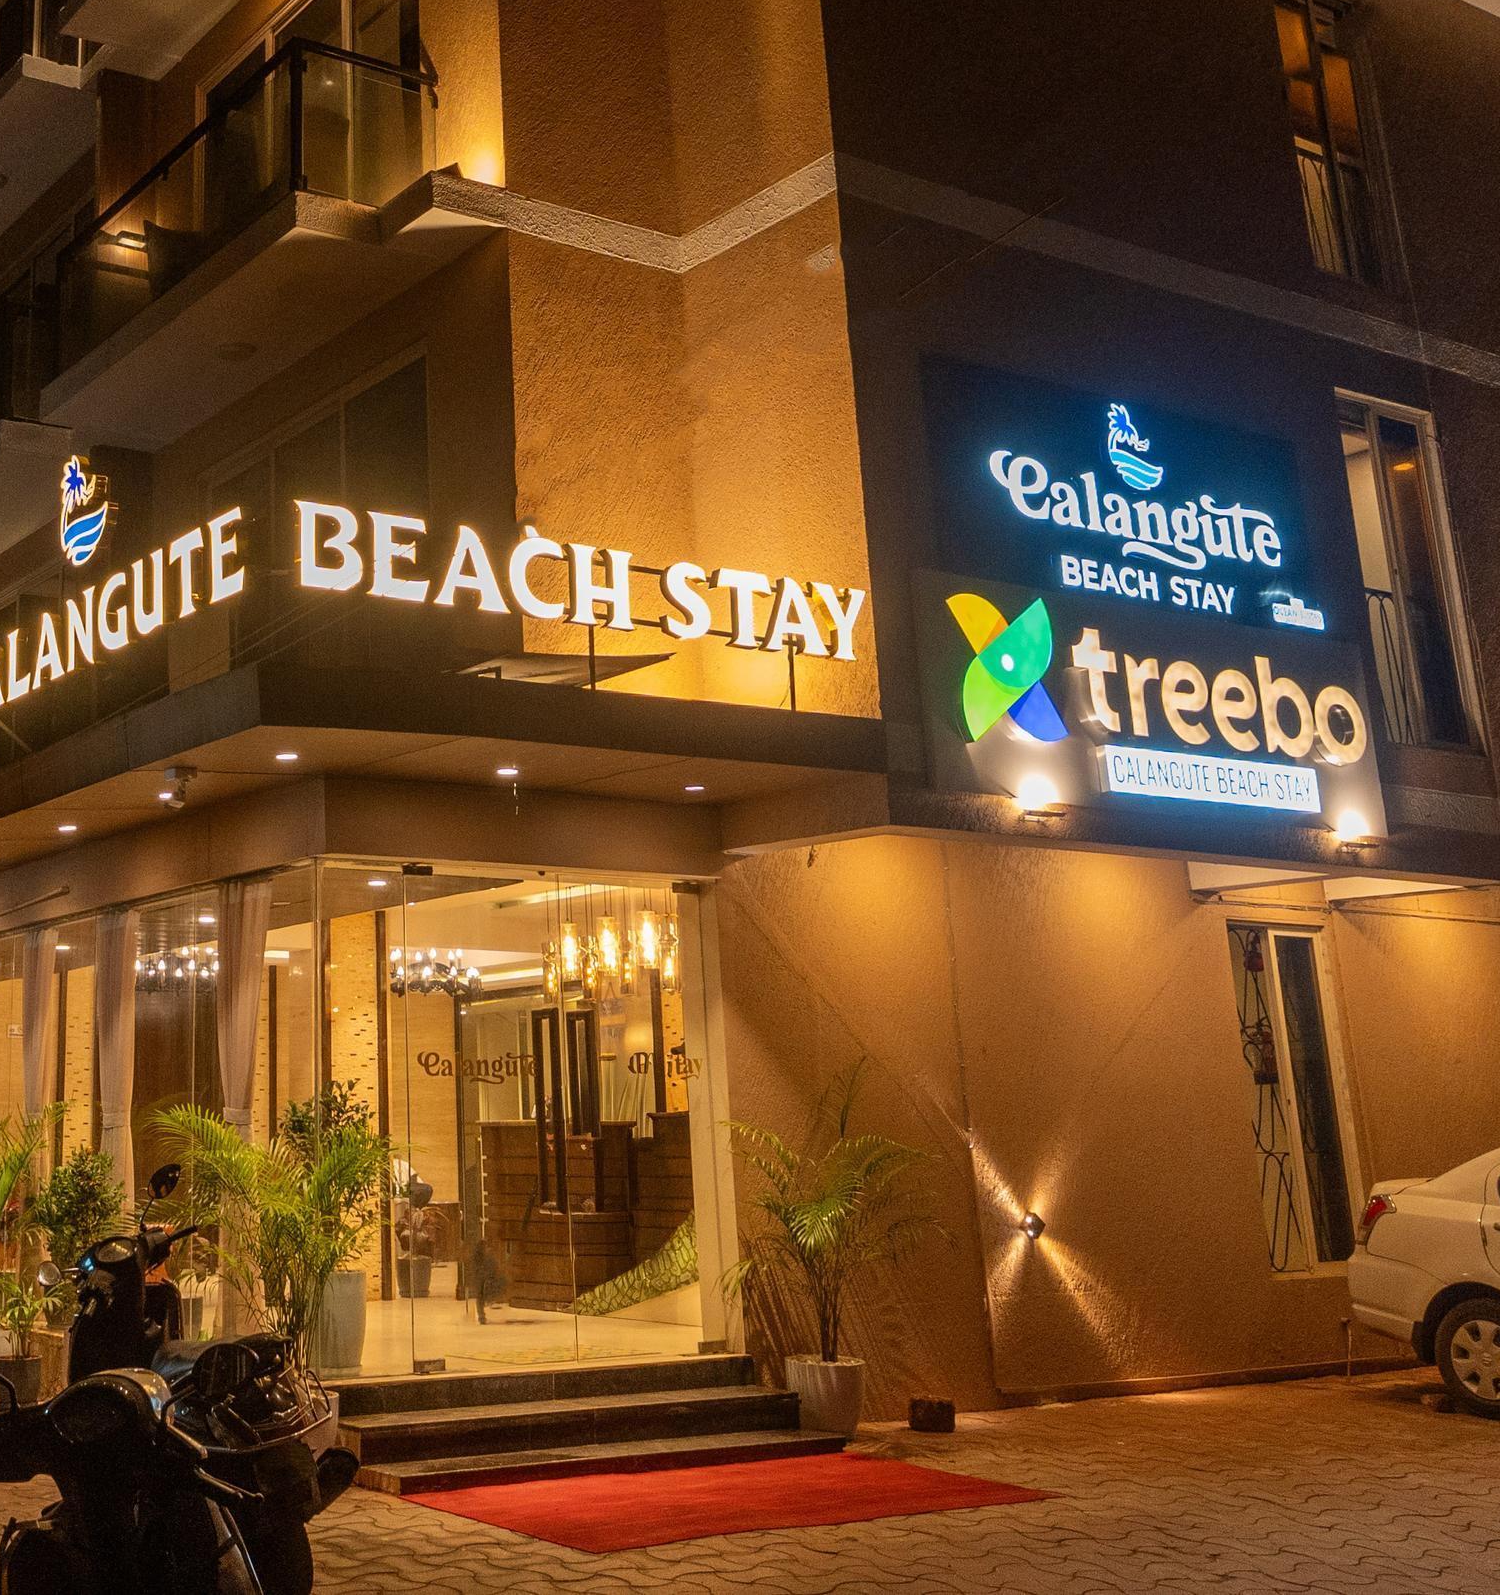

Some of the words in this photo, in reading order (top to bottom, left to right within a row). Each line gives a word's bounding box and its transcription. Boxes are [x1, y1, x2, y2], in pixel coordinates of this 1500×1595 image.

[988, 450, 1283, 571] Calangute
[296, 499, 633, 632] BEACH
[659, 561, 866, 662] STAY
[1061, 555, 1161, 602] BEACH
[1171, 576, 1236, 615] STAY
[1071, 627, 1368, 765] treebo
[1113, 755, 1211, 792] CALANGUTE
[1216, 766, 1271, 799] BEACH
[1274, 773, 1312, 803] STAY
[417, 1051, 538, 1085] Caangute
